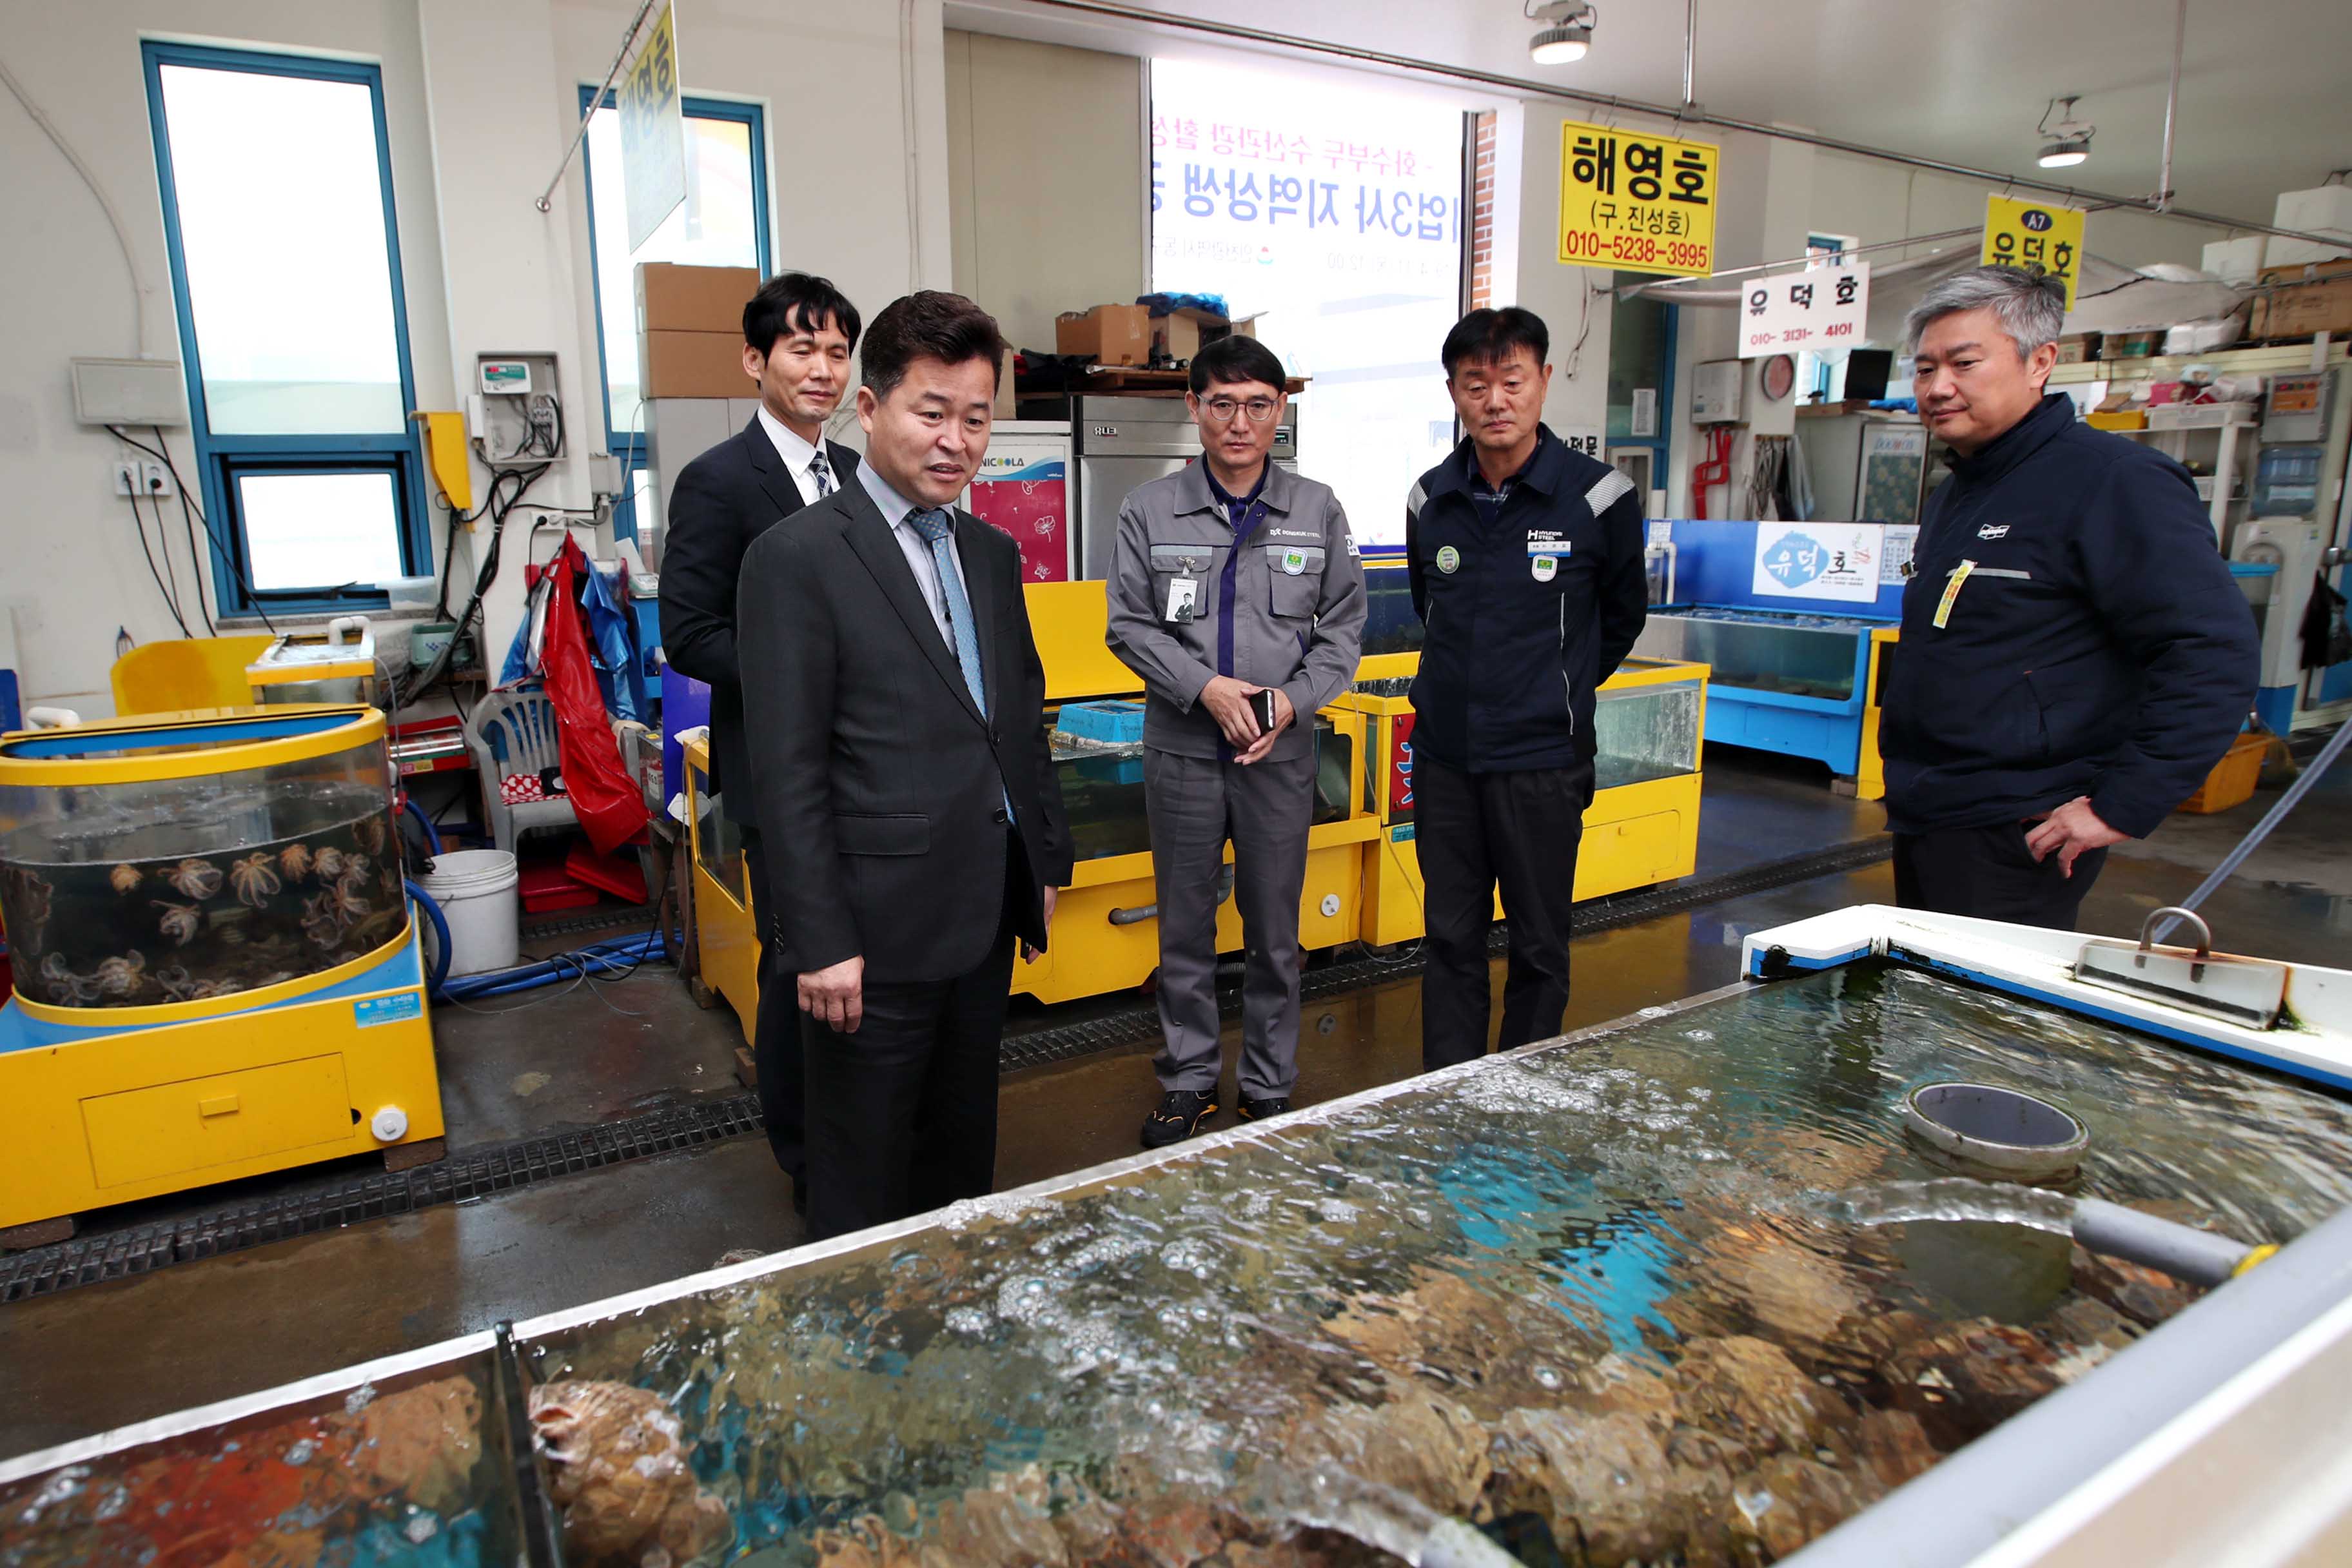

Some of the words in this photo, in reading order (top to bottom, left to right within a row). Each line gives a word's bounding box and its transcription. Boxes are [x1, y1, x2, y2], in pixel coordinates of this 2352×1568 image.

[1573, 136, 1709, 205] 해영호
[2027, 213, 2046, 230] A7
[1567, 230, 1707, 268] 010-5238-3995
